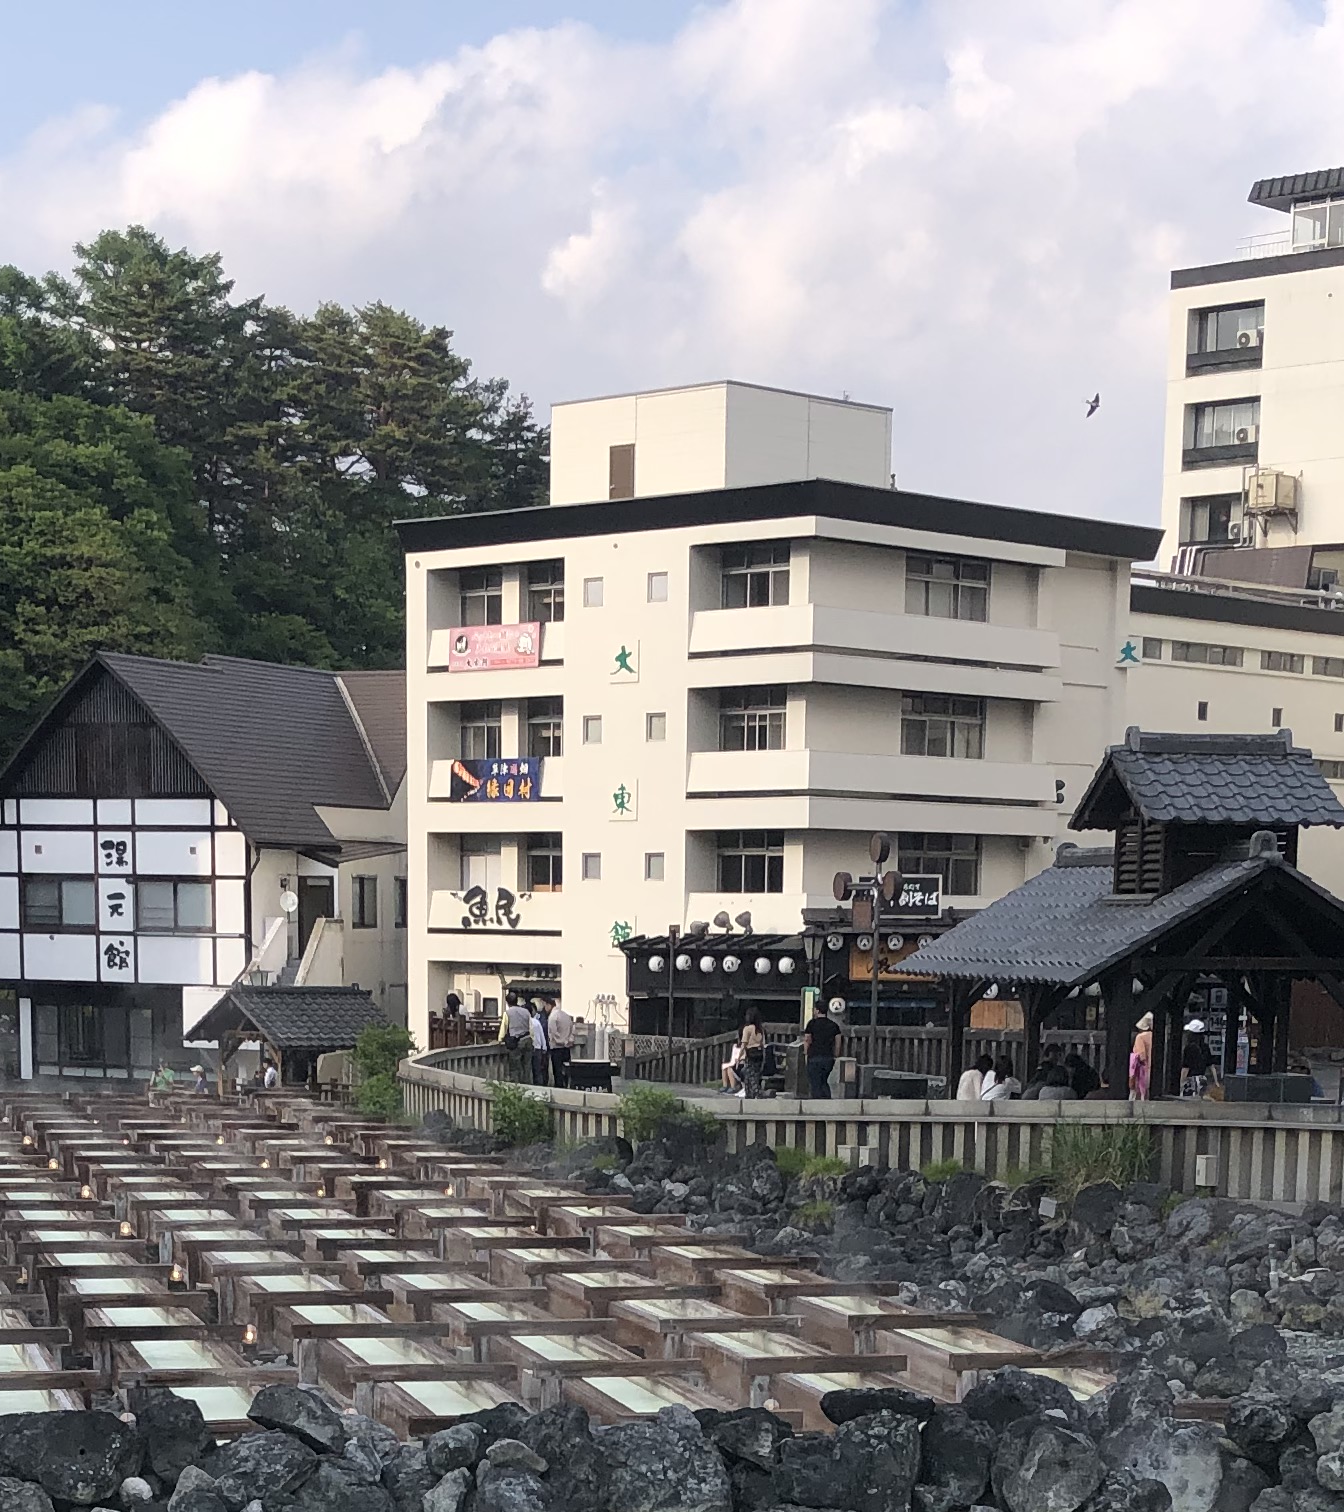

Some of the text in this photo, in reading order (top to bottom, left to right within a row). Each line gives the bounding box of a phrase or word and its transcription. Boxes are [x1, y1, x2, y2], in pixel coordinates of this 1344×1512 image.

[100, 840, 131, 970] 湯元館
[461, 885, 521, 929] 魚民
